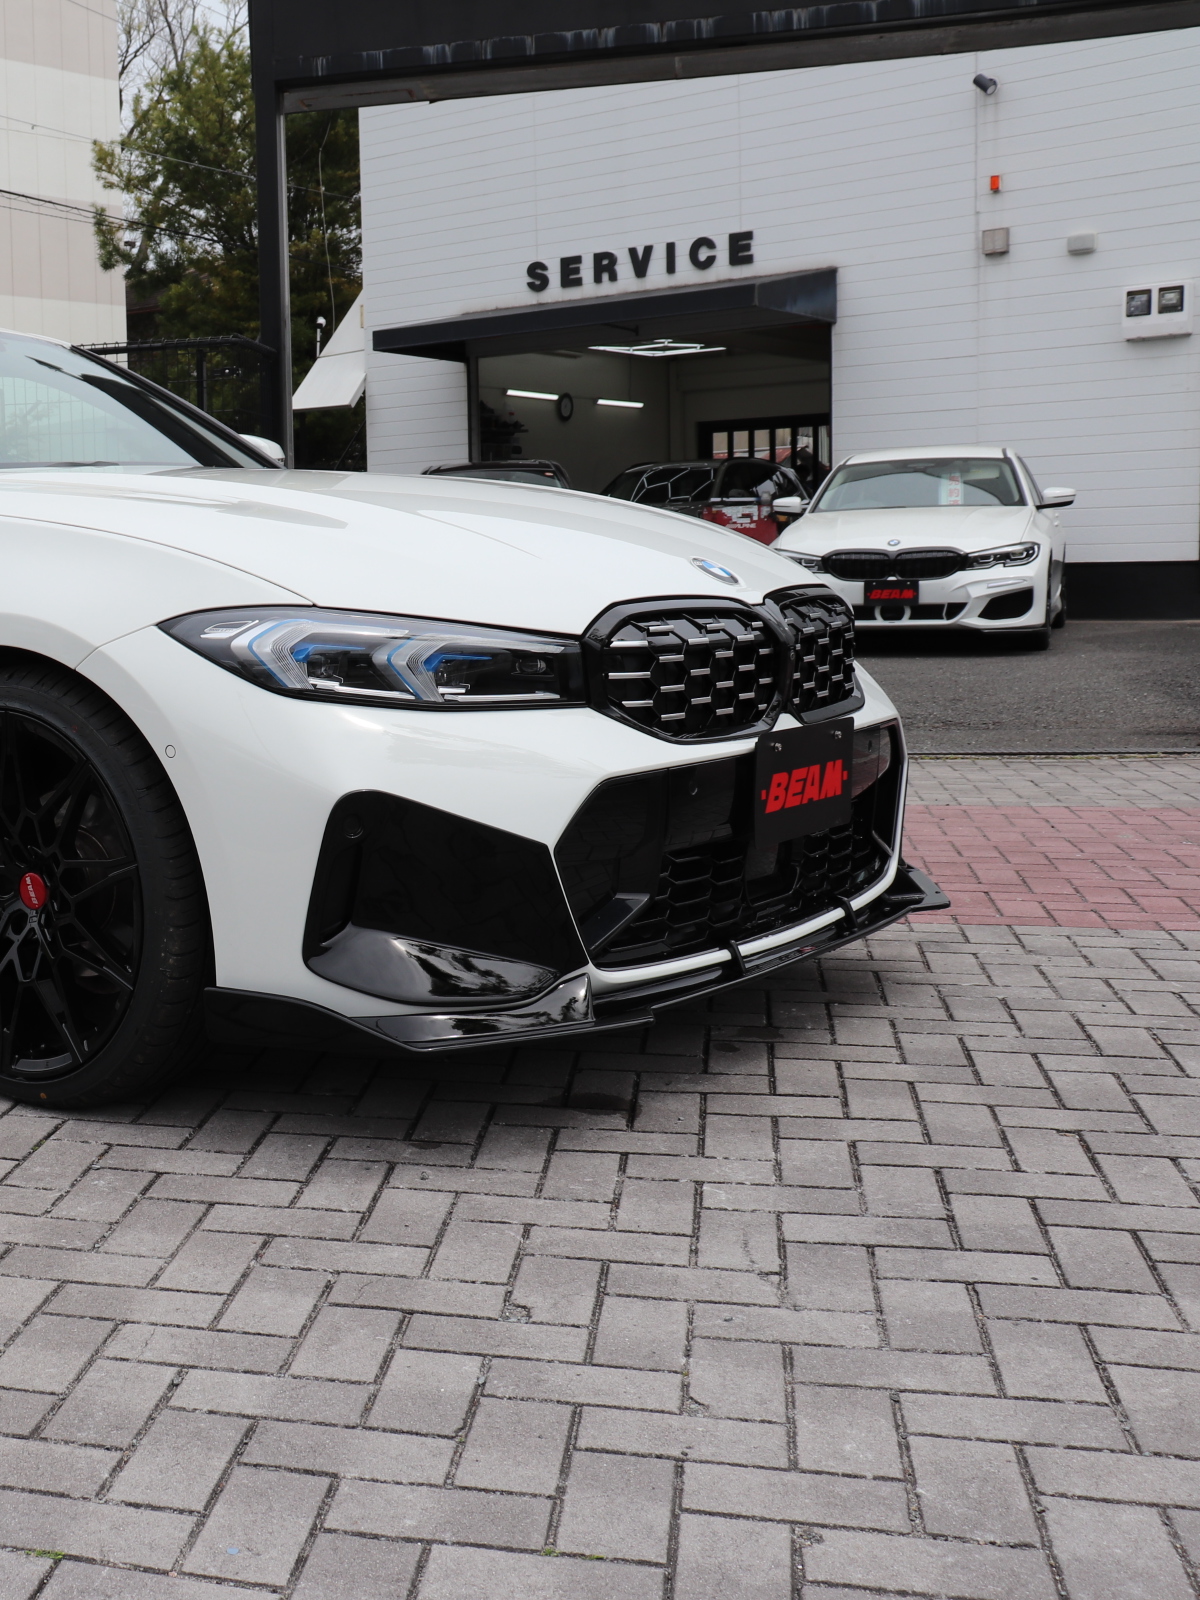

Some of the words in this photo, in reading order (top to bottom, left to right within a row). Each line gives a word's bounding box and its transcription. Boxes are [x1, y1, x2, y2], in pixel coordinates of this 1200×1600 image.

[526, 231, 754, 292] SERVICE
[869, 589, 914, 599] BEAM
[765, 759, 843, 813] BEAM
